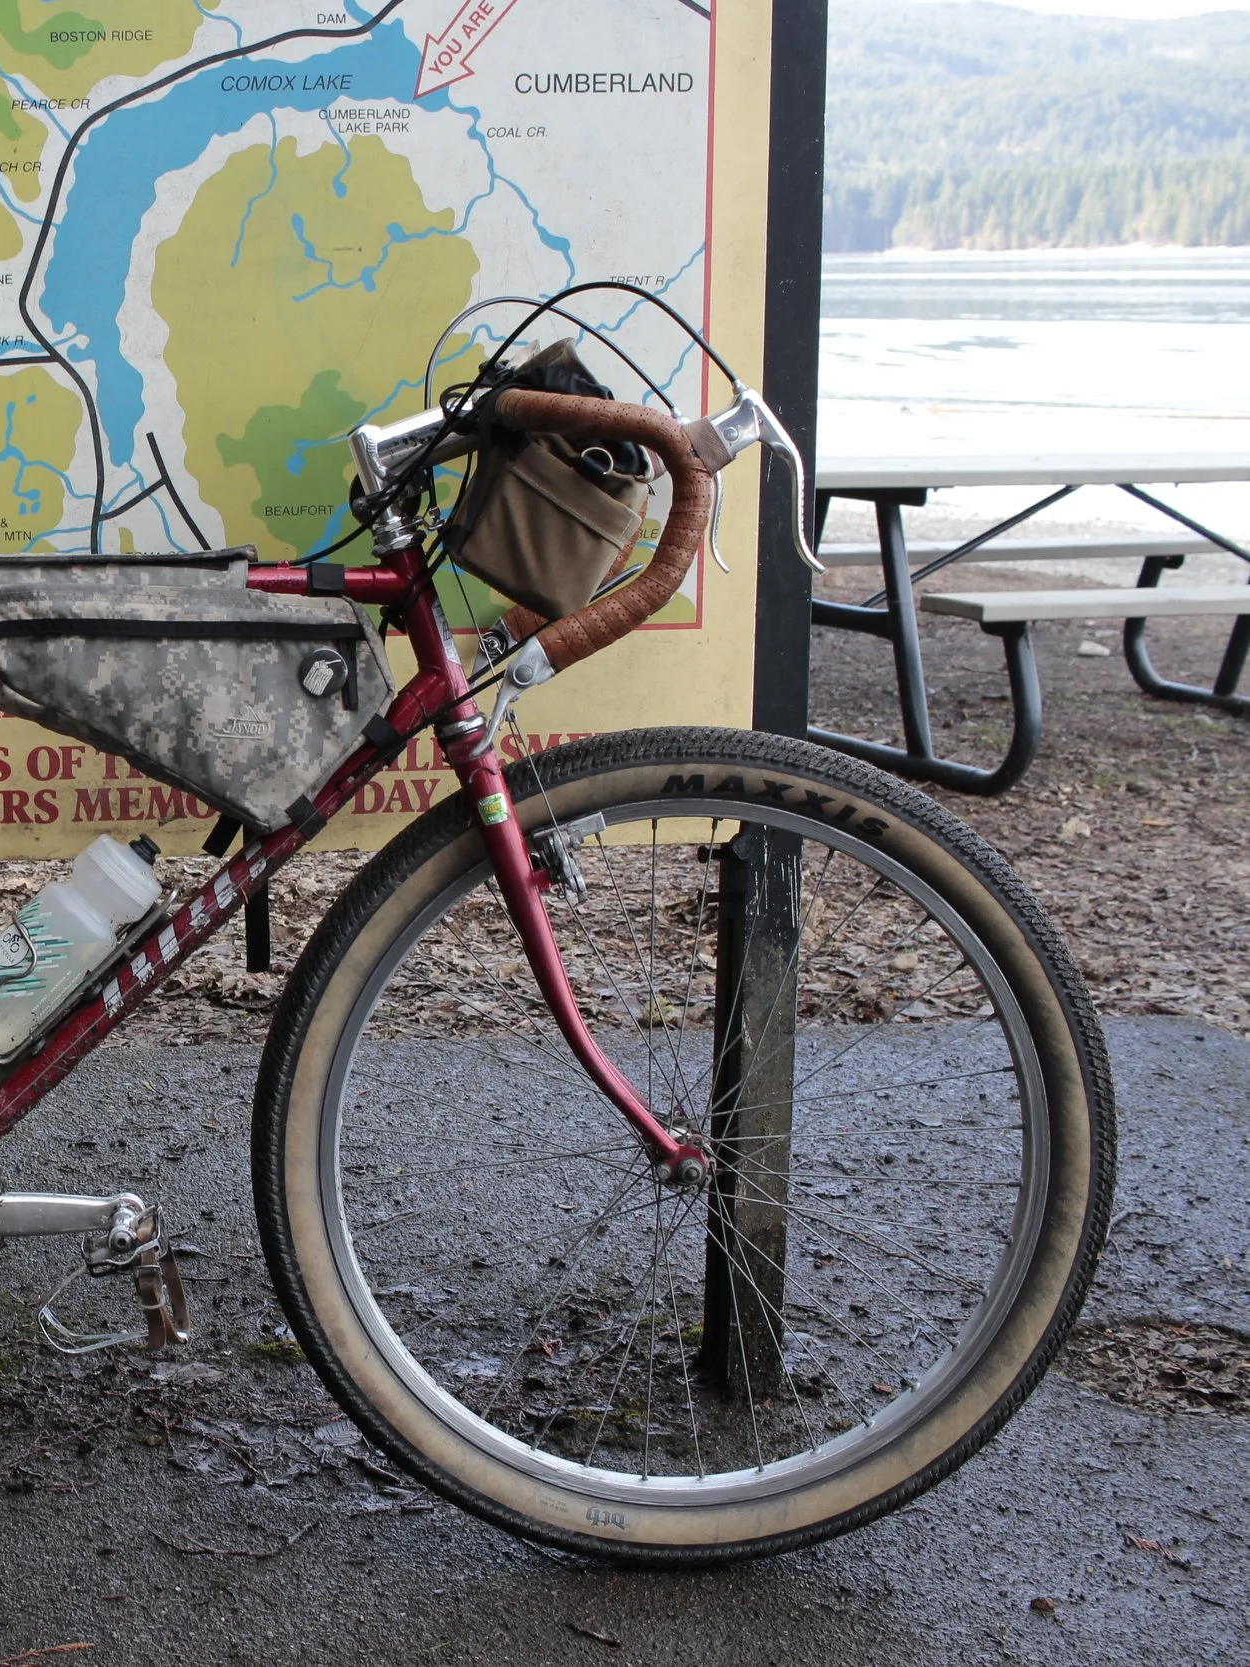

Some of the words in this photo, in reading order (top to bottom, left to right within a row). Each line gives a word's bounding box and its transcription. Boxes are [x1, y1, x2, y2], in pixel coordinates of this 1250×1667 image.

[317, 13, 346, 25] DAM
[50, 31, 106, 42] BOSTON
[111, 30, 152, 41] RIDGE
[428, 38, 462, 74] YOU
[461, 0, 494, 39] ARE
[221, 76, 296, 91] COMOX
[302, 74, 353, 91] LAKE
[515, 73, 694, 94] CUMBERLAND
[11, 99, 67, 110] PEARCE
[318, 109, 411, 120] CUMBERLAND
[338, 123, 371, 133] LAKE
[375, 122, 410, 133] PARK
[486, 127, 522, 138] COAL
[526, 127, 548, 138] CR.
[22, 161, 44, 172] CR.
[609, 276, 652, 286] TRENT
[14, 335, 26, 345] R.
[265, 505, 334, 516] BEAUFORT
[0, 518, 8, 528] &
[5, 530, 35, 541] MTN.
[27, 746, 83, 781] OF
[351, 779, 440, 815] DAY
[661, 774, 889, 837] MAXXIS
